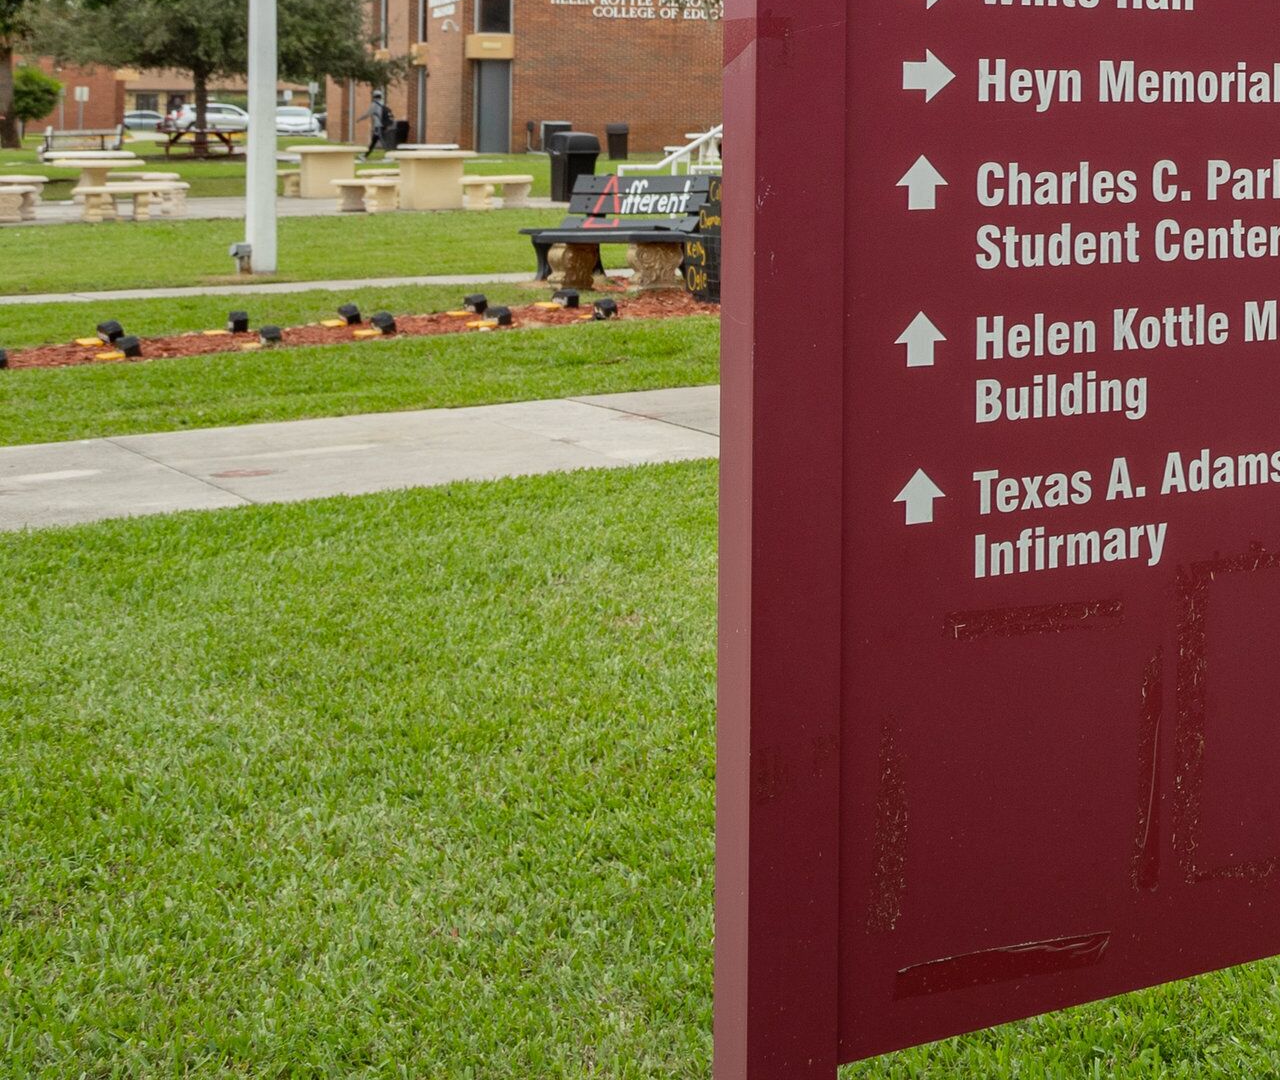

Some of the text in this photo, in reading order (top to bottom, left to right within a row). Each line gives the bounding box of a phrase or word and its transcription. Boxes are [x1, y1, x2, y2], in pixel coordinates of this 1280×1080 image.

[592, 6, 656, 19] COLLEGE
[659, 7, 681, 19] OF
[977, 58, 1082, 113] Heyn
[976, 161, 1137, 207] Charles
[1152, 159, 1191, 203] C.
[975, 222, 1140, 270] Student
[975, 312, 1096, 361] Helen
[1113, 303, 1229, 351] Kottle
[975, 370, 1148, 424] Building
[972, 469, 1092, 515] Texas
[1105, 456, 1146, 501] A.
[974, 522, 1168, 579] Infirmary
